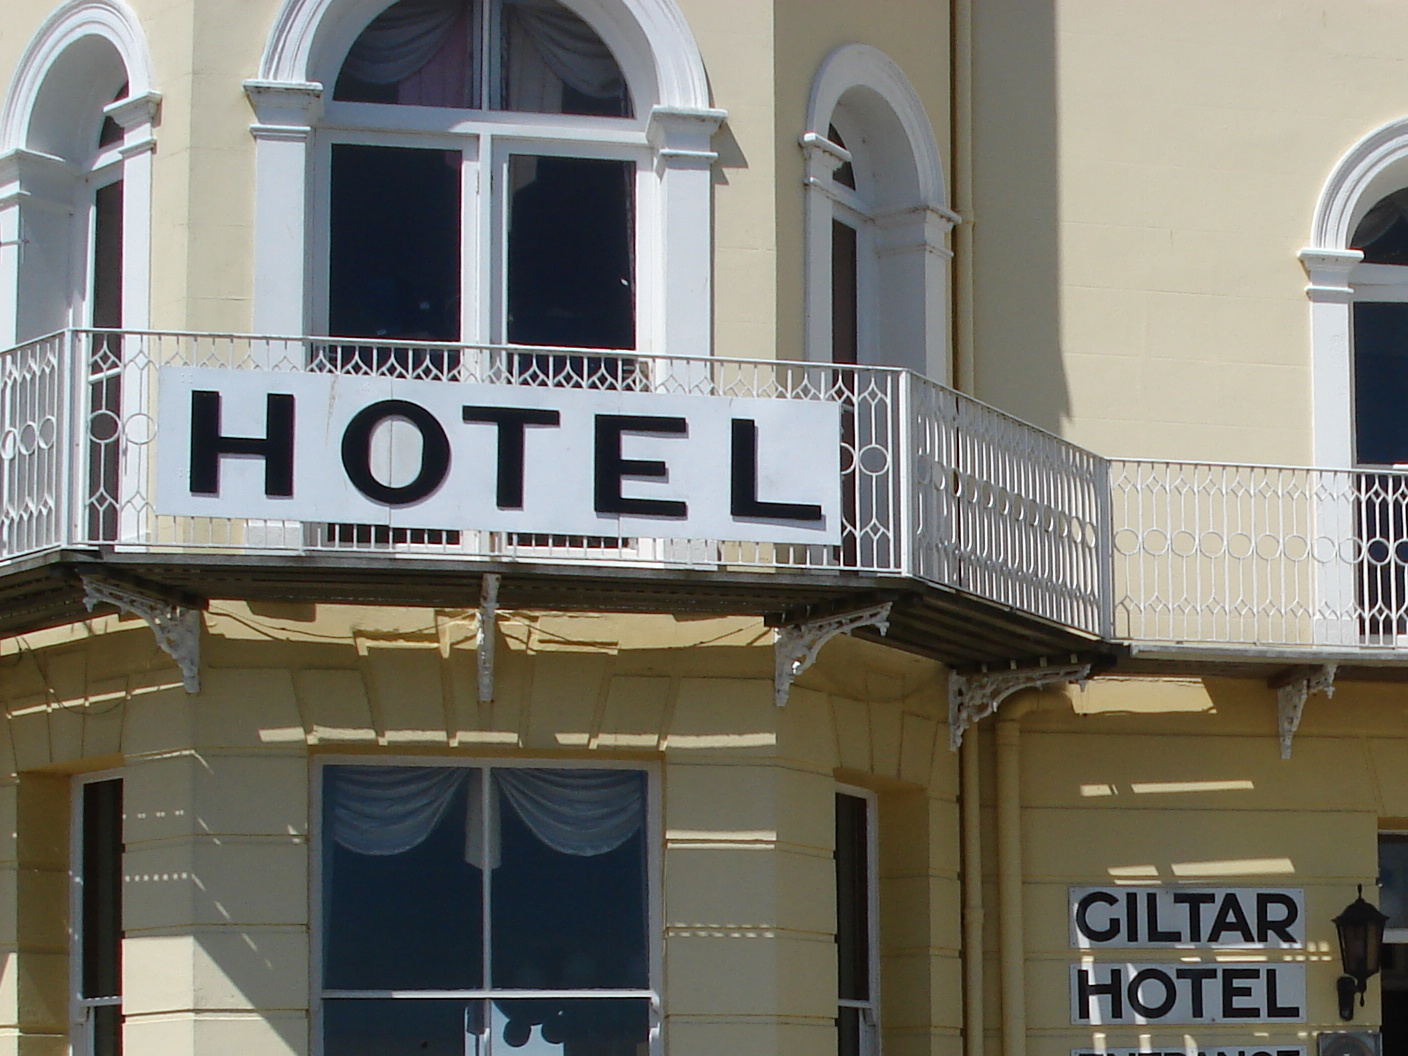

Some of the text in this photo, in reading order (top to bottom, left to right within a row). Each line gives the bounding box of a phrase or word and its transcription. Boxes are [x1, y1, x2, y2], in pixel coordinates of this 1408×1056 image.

[189, 389, 823, 521] HOTEL
[1076, 891, 1299, 943] GILTAR
[1078, 968, 1300, 1020] HOTEL
